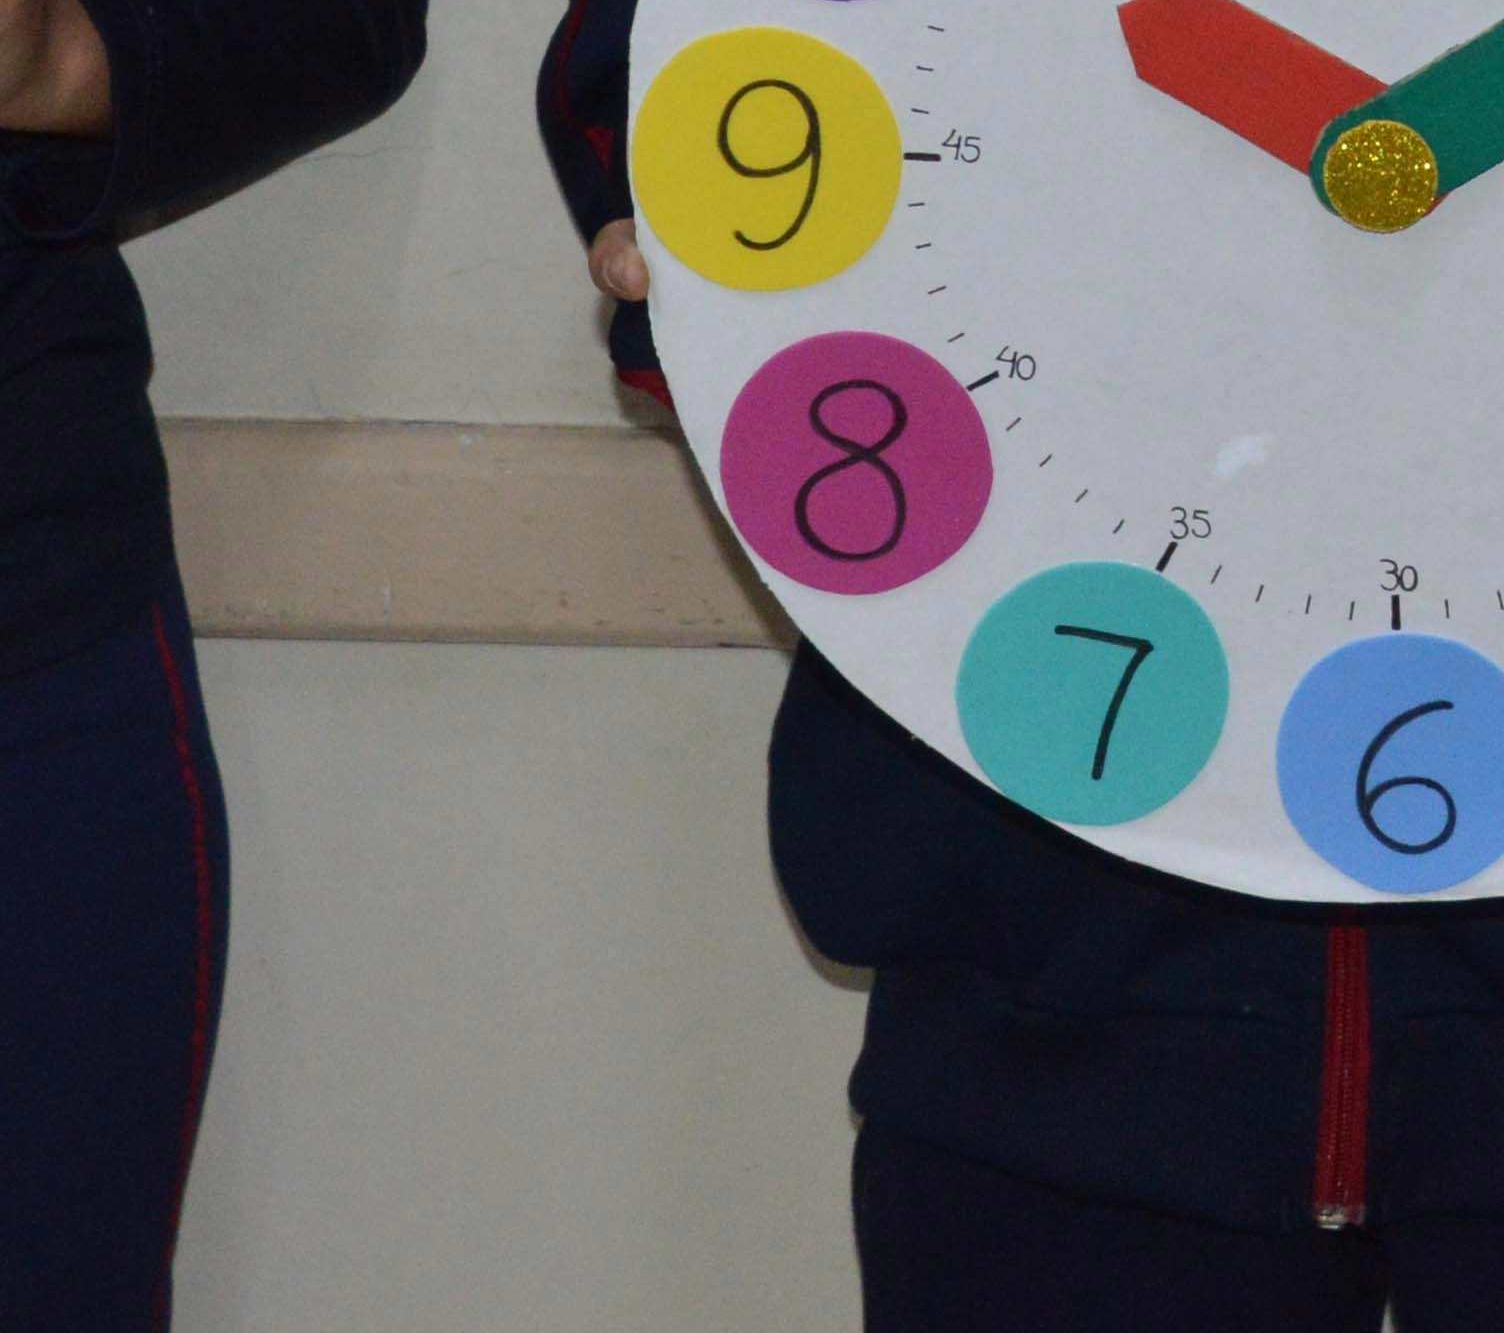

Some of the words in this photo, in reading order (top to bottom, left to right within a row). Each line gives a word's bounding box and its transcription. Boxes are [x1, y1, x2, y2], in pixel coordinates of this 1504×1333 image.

[717, 79, 822, 251] 9
[941, 129, 981, 164] 45
[996, 346, 1036, 381] 40
[794, 379, 908, 562] 8
[1170, 505, 1212, 541] 35
[1381, 558, 1419, 593] 30
[1053, 624, 1155, 781] 7
[1355, 699, 1457, 856] 6
